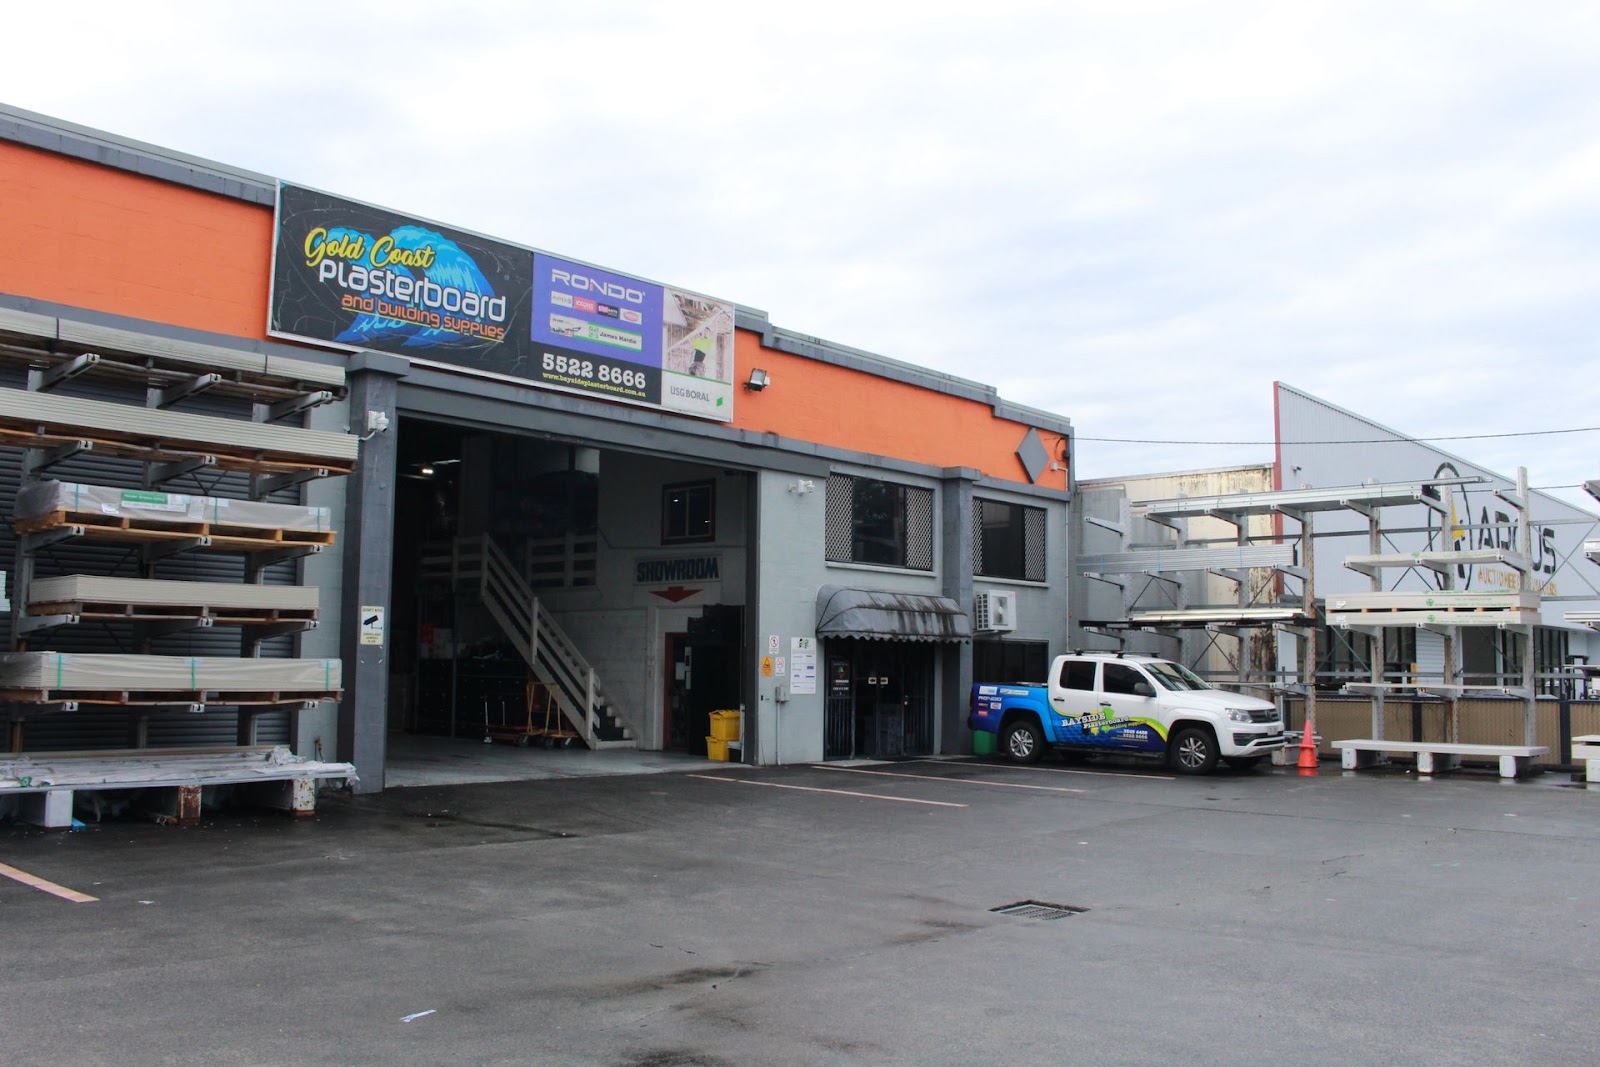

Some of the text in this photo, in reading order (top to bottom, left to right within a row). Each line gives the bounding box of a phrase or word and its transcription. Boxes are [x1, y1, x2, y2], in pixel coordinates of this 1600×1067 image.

[304, 227, 436, 268] Gold Coast
[551, 268, 643, 304] RONDO
[341, 293, 505, 341] and building supplies
[600, 331, 637, 344] James Hardie
[542, 352, 646, 389] 5522 8666
[542, 372, 646, 397] www.baysideplasterboard.com.au
[637, 556, 720, 583] SHOWROOM
[1062, 713, 1106, 727] BAYSIDE
